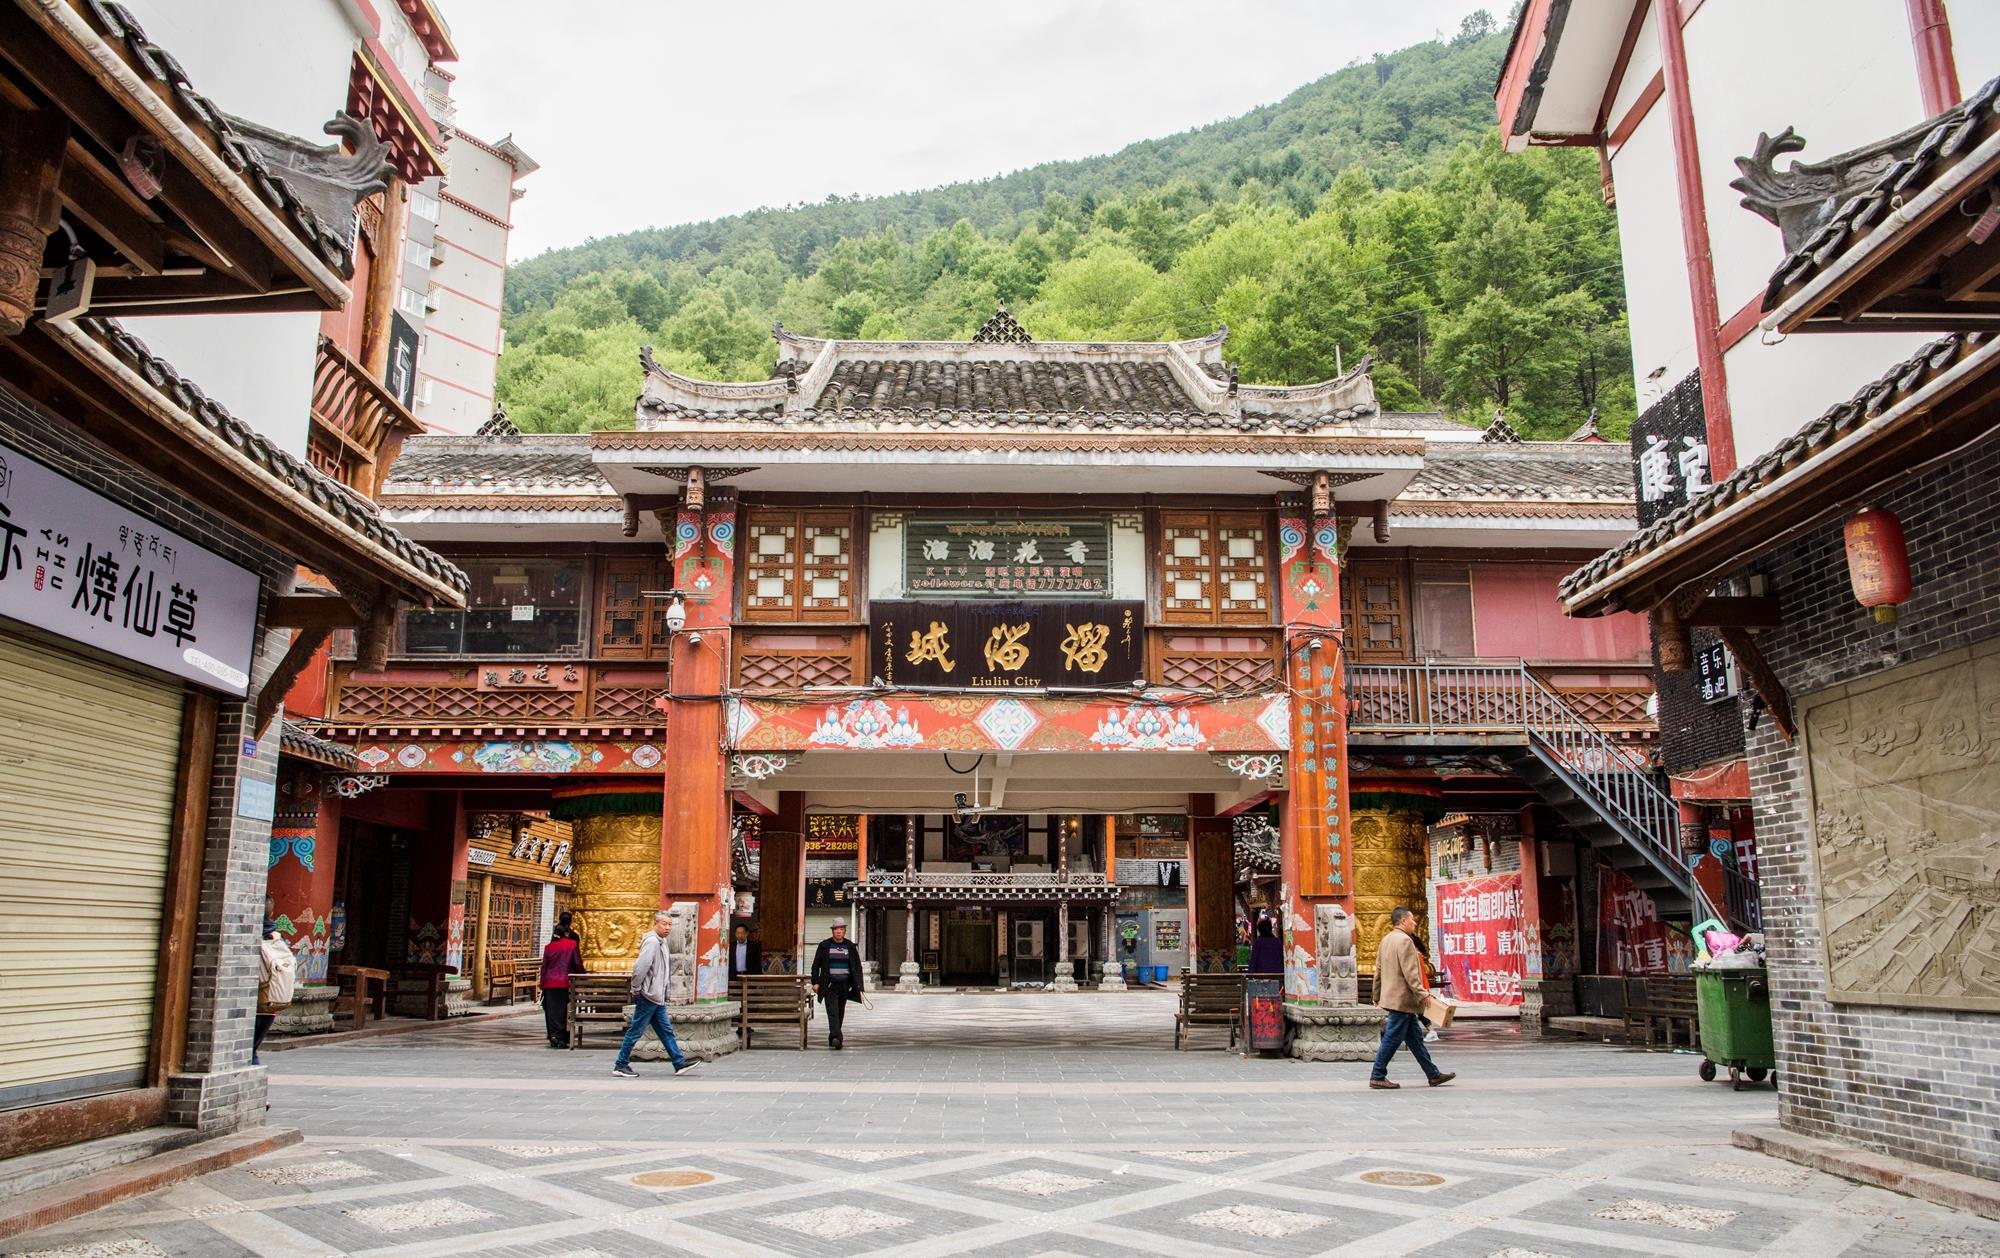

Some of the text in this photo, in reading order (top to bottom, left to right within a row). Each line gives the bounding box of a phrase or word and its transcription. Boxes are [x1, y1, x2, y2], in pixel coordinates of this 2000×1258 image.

[923, 539, 1090, 564] 溜溜花香
[1700, 647, 1722, 675] 音乐
[972, 676, 1041, 687] Liuliu City
[1701, 676, 1725, 700] 酒吧
[1443, 931, 1487, 955] 施工重地
[1469, 969, 1523, 996] 注意安全
